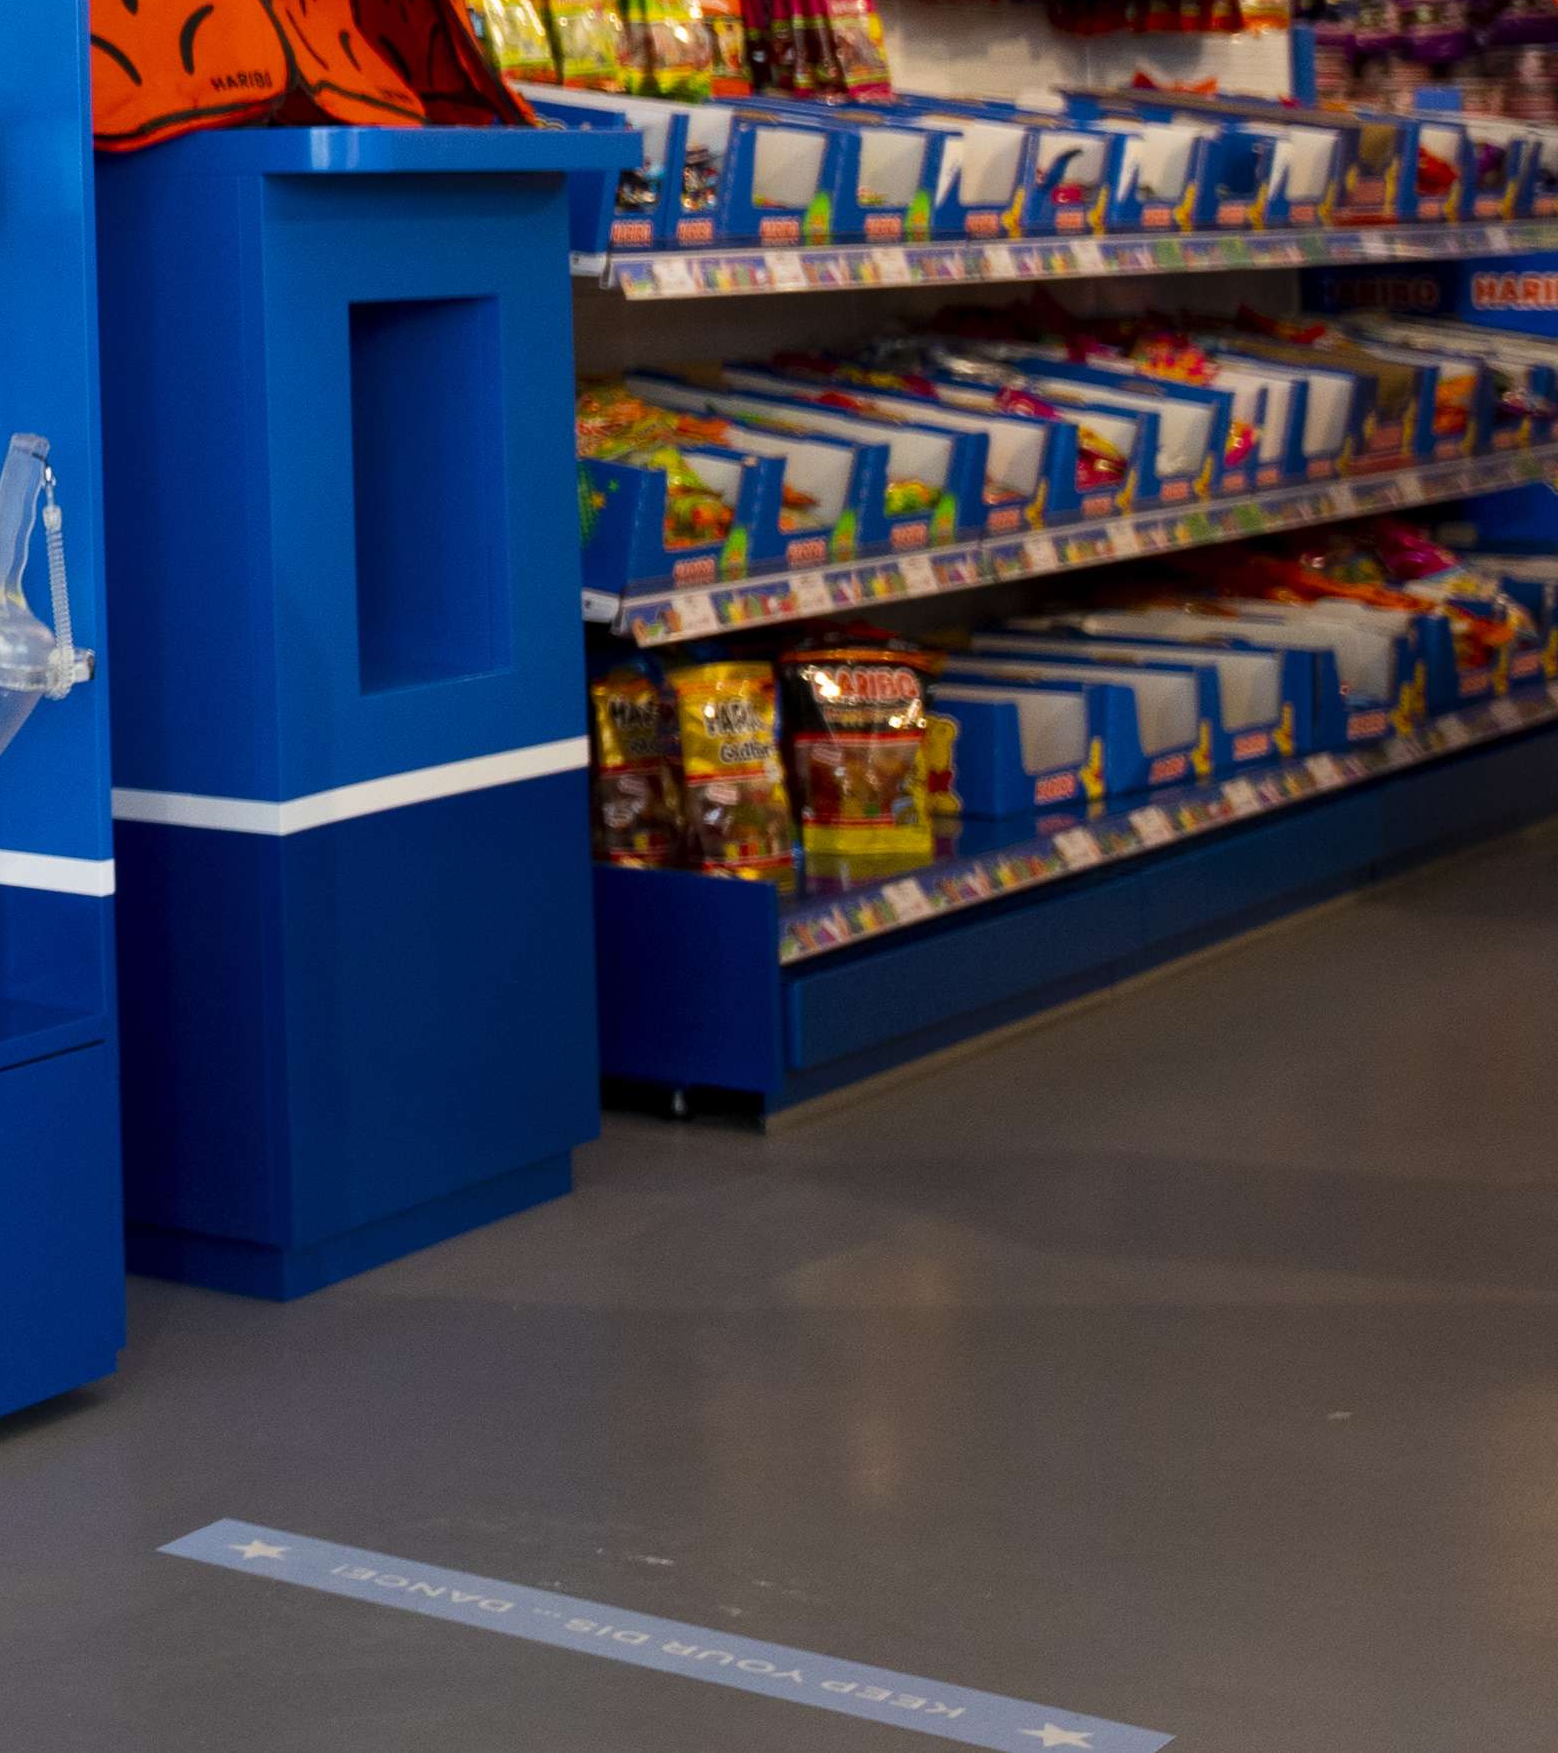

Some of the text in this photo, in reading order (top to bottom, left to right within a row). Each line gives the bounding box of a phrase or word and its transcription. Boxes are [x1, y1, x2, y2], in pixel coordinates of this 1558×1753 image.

[1477, 276, 1558, 305] HARI
[330, 1562, 514, 1614] DANCE!
[661, 1640, 805, 1686] YOUR
[821, 1680, 967, 1720] KEEP
